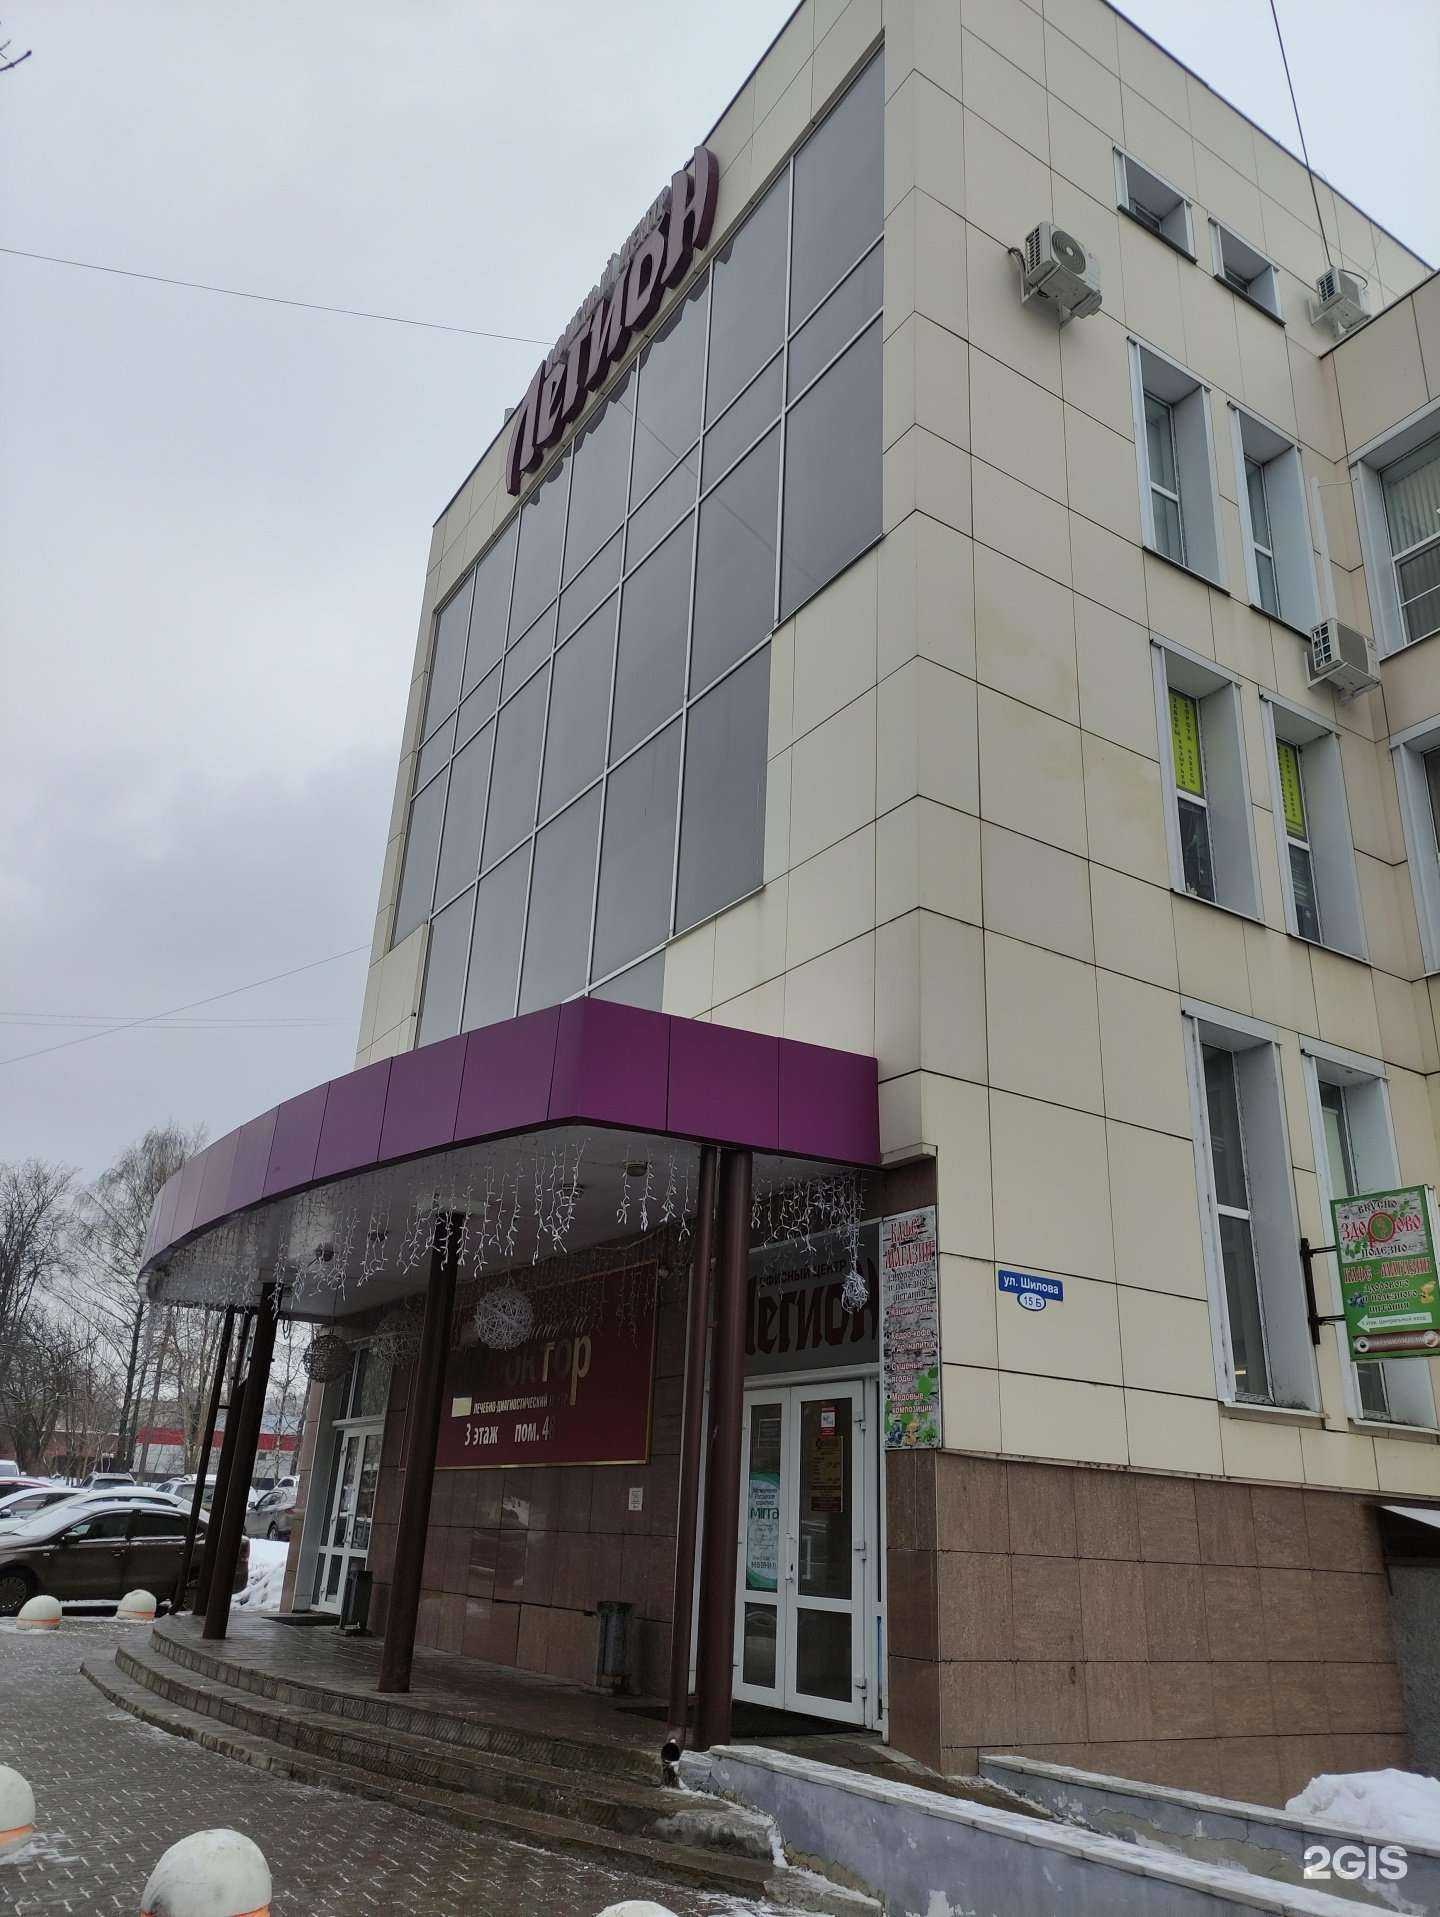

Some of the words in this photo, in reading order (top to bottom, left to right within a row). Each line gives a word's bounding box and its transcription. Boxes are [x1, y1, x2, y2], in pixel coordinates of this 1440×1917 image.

[1003, 1275, 1018, 1288] ул.
[1021, 1276, 1059, 1294] Шилова
[464, 1422, 472, 1446] 3
[472, 1424, 499, 1446] этаж
[514, 1421, 539, 1444] пом.
